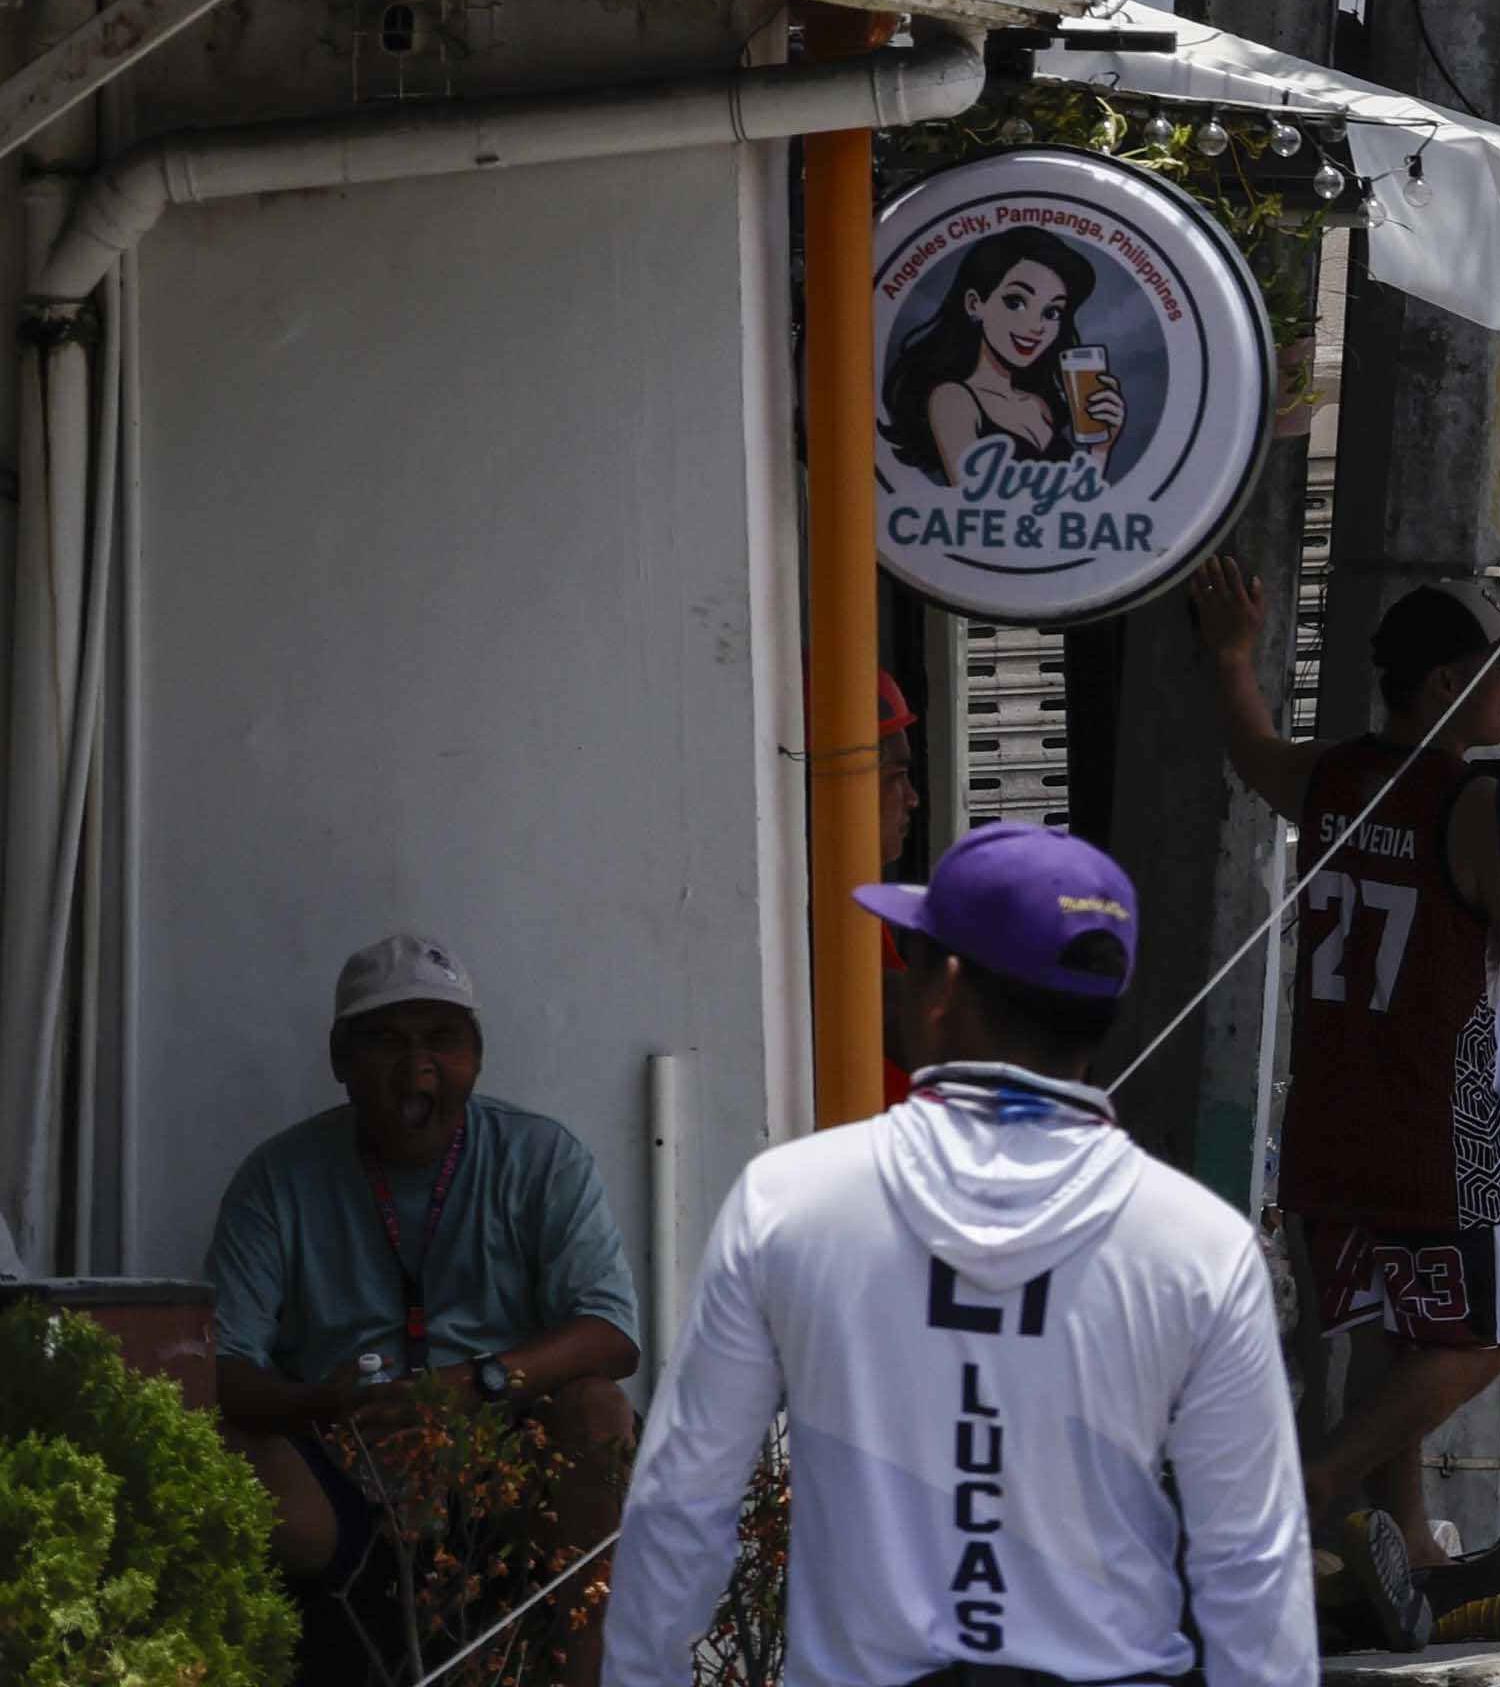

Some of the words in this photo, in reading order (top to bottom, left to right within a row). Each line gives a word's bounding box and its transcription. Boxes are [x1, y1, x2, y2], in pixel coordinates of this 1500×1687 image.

[882, 232, 949, 302] Angeles
[947, 213, 993, 242] City,
[996, 205, 1105, 241] Pampanga,
[1107, 228, 1185, 324] Philippines
[888, 507, 1007, 549] CAFE
[1013, 514, 1044, 550] &
[1058, 512, 1154, 553] BAR
[962, 439, 1103, 518] Ivy's
[1305, 869, 1418, 1013] 27
[951, 1363, 1007, 1652] LUCAS
